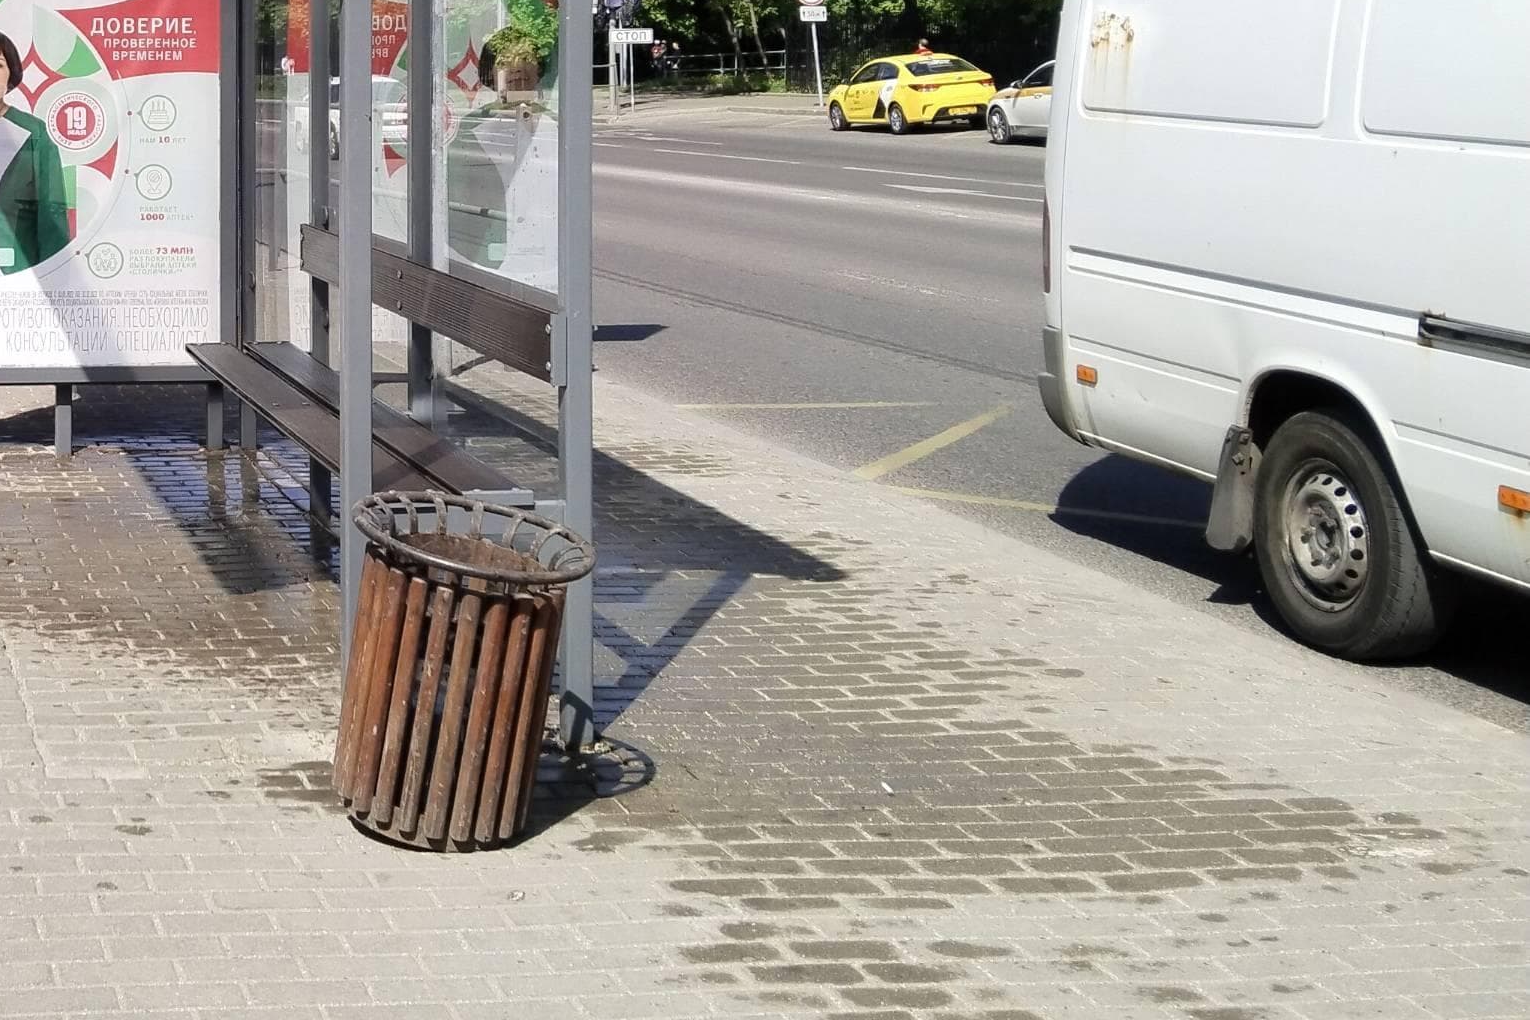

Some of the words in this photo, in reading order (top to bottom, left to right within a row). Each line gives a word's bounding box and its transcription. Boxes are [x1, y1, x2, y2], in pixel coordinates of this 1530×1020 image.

[616, 31, 647, 41] СТОП
[104, 38, 197, 49] ПРОВЕРЕННОЕ
[112, 50, 183, 61] ВРЕМЕНЕМ
[63, 106, 87, 130] 19
[158, 136, 171, 144] 10
[140, 213, 165, 221] 1000
[156, 247, 168, 255] 73
[170, 247, 194, 255] МЛН
[123, 306, 209, 330] НЕОБХОДИМО
[6, 330, 108, 353] КОНСУЛЬТАЦИИ
